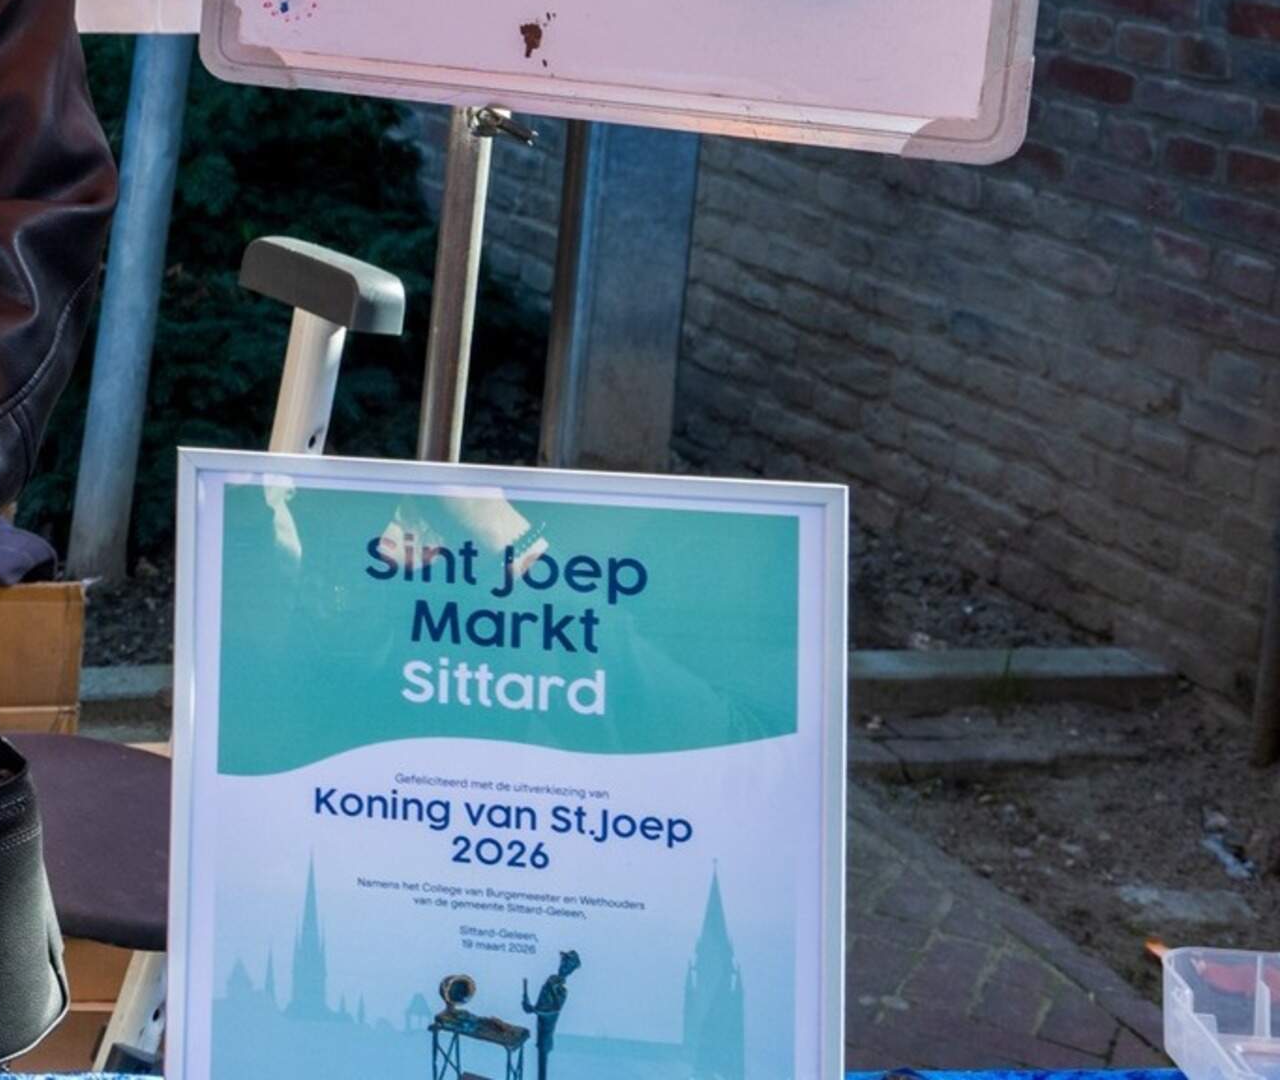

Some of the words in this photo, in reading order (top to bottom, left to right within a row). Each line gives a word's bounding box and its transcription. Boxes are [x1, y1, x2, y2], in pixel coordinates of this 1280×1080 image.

[365, 533, 478, 586] Sint
[490, 544, 649, 605] Joep
[411, 599, 600, 654] Markt
[401, 656, 606, 716] Sittard
[394, 772, 468, 790] Gefeliciteerd
[471, 779, 494, 791] met
[496, 781, 511, 793] de
[513, 782, 586, 802] uitverkiezing
[588, 788, 610, 800] van
[314, 787, 451, 831] Koning
[464, 801, 537, 831] van
[550, 804, 693, 849] St.Joep
[451, 835, 550, 870] 2026
[357, 876, 400, 890] Namens
[402, 880, 420, 892] het
[422, 882, 462, 897] College
[465, 887, 484, 898] van
[486, 887, 561, 905] Burgemeester
[563, 894, 578, 905] en
[580, 894, 645, 911] Wethouders
[413, 896, 435, 907] van
[436, 896, 449, 908] de
[451, 900, 505, 913] gemeente
[476, 941, 506, 953] maart
